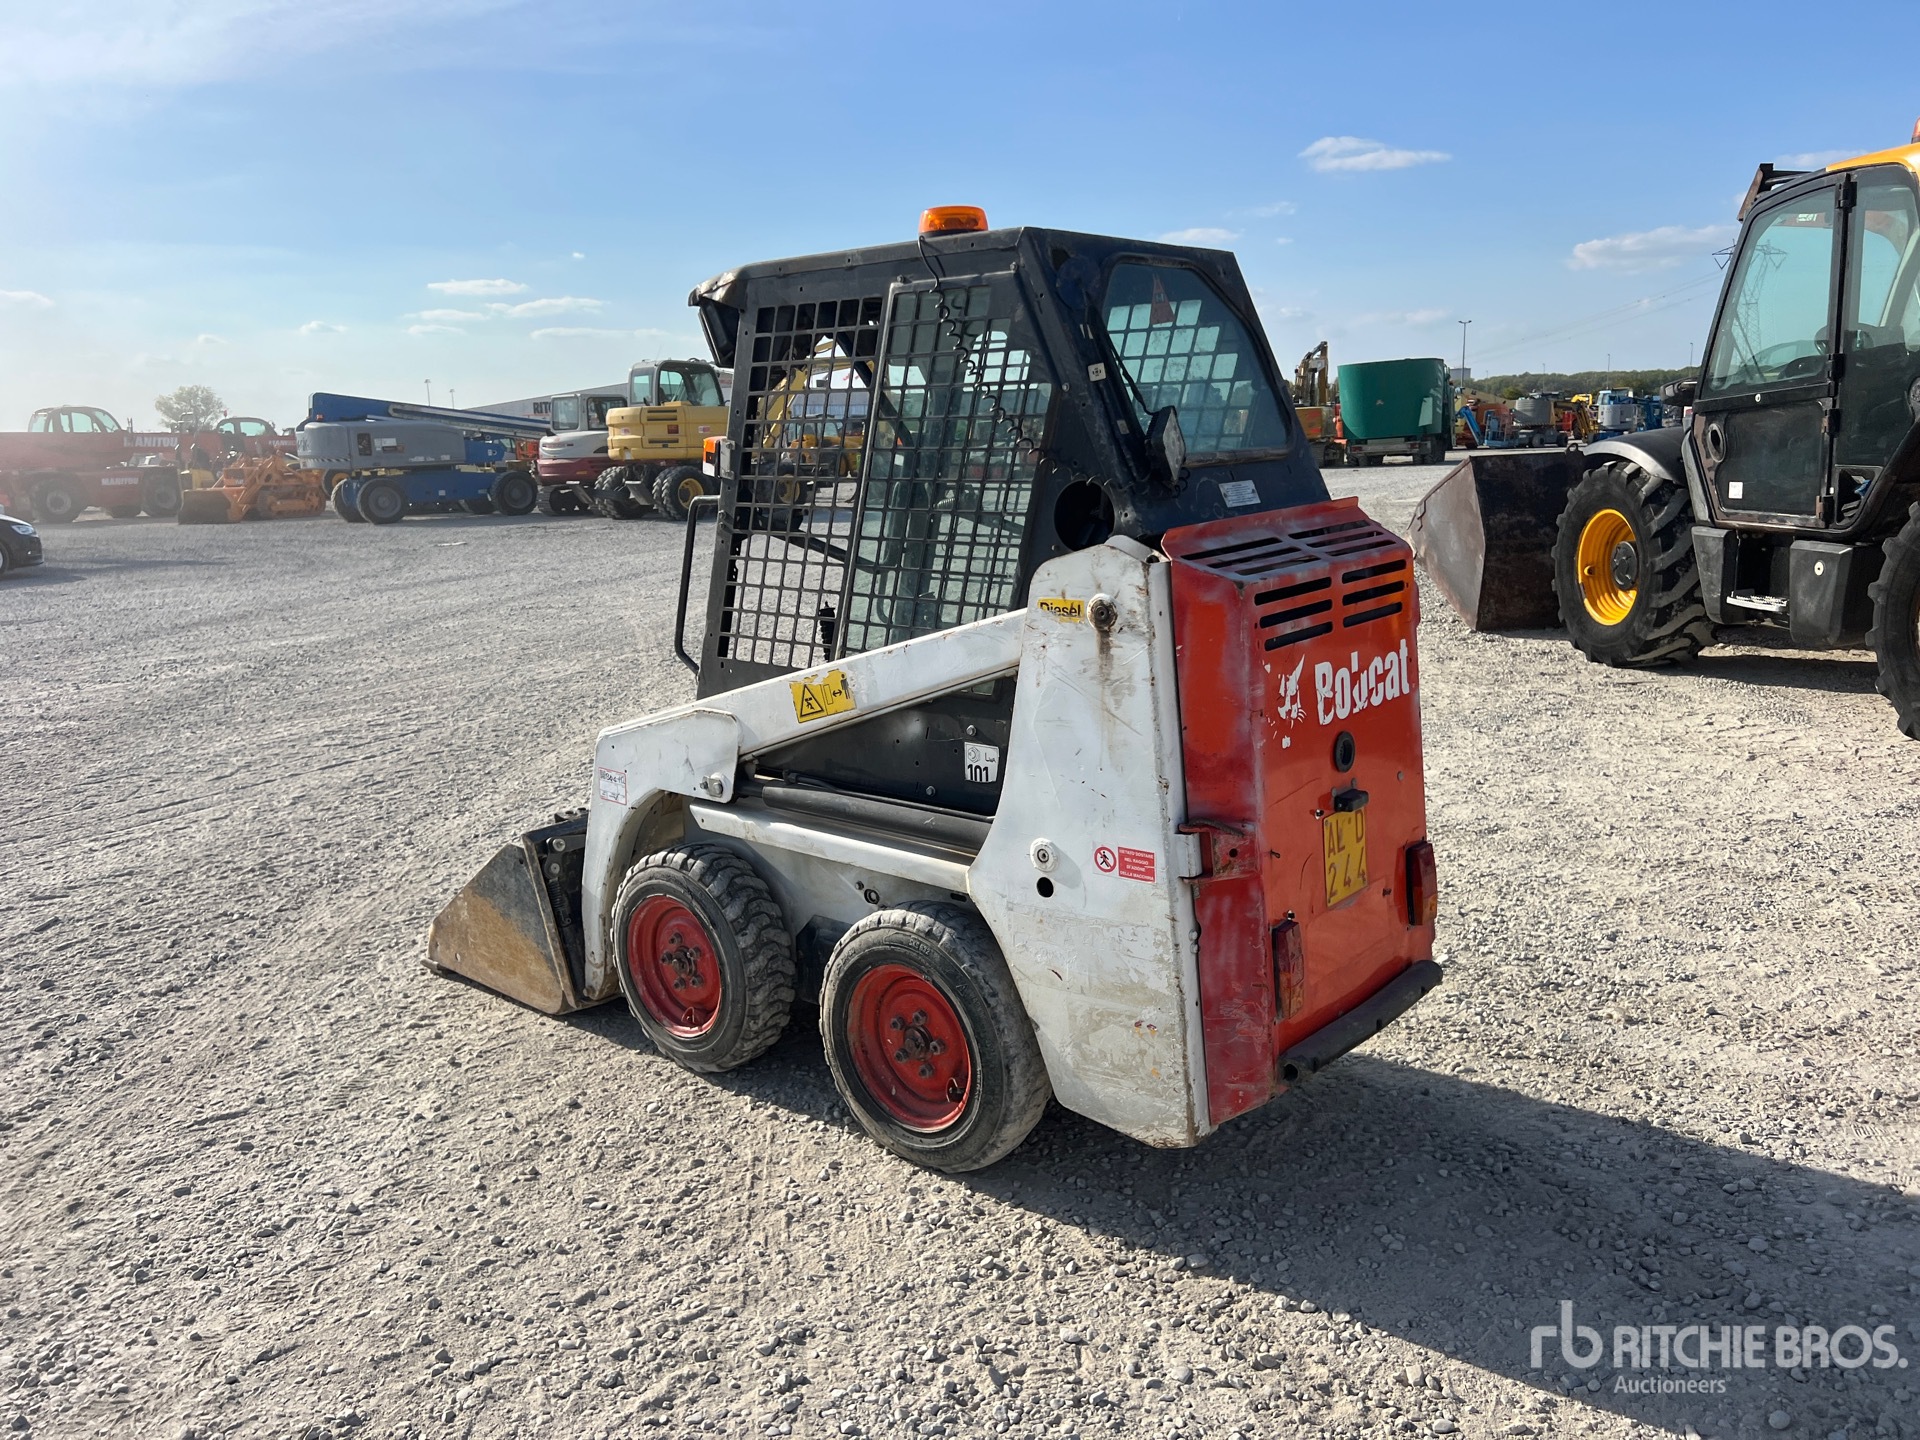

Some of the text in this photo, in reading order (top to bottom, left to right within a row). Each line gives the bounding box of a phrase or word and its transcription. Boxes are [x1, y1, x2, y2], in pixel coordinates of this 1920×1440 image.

[1039, 602, 1081, 618] Diesel
[967, 763, 989, 782] 101
[1328, 847, 1366, 898] 244
